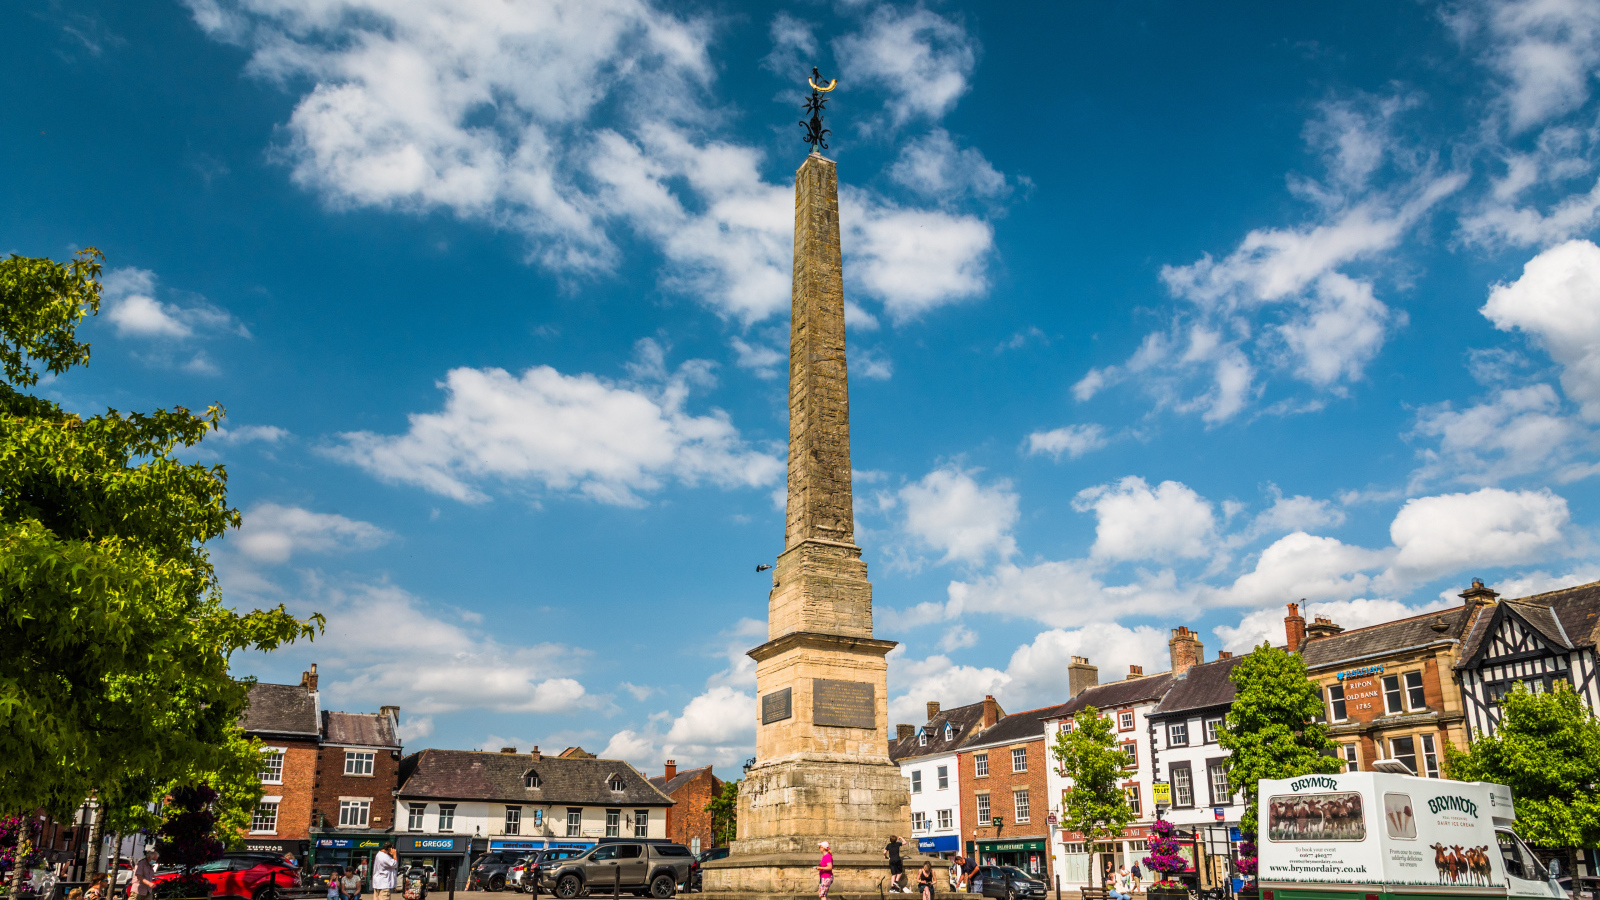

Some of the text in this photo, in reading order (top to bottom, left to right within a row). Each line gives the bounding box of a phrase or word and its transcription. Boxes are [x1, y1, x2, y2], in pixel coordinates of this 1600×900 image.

[1346, 664, 1384, 678] BARCLAYS
[1350, 680, 1372, 690] RIPON
[1361, 690, 1379, 699] BANK
[1291, 777, 1337, 791] BRYMOR
[1428, 796, 1478, 819] BRYMOR
[1071, 832, 1081, 840] The
[422, 840, 452, 848] GREGGS
[1269, 863, 1367, 875] www.brymordairy.co.uk
